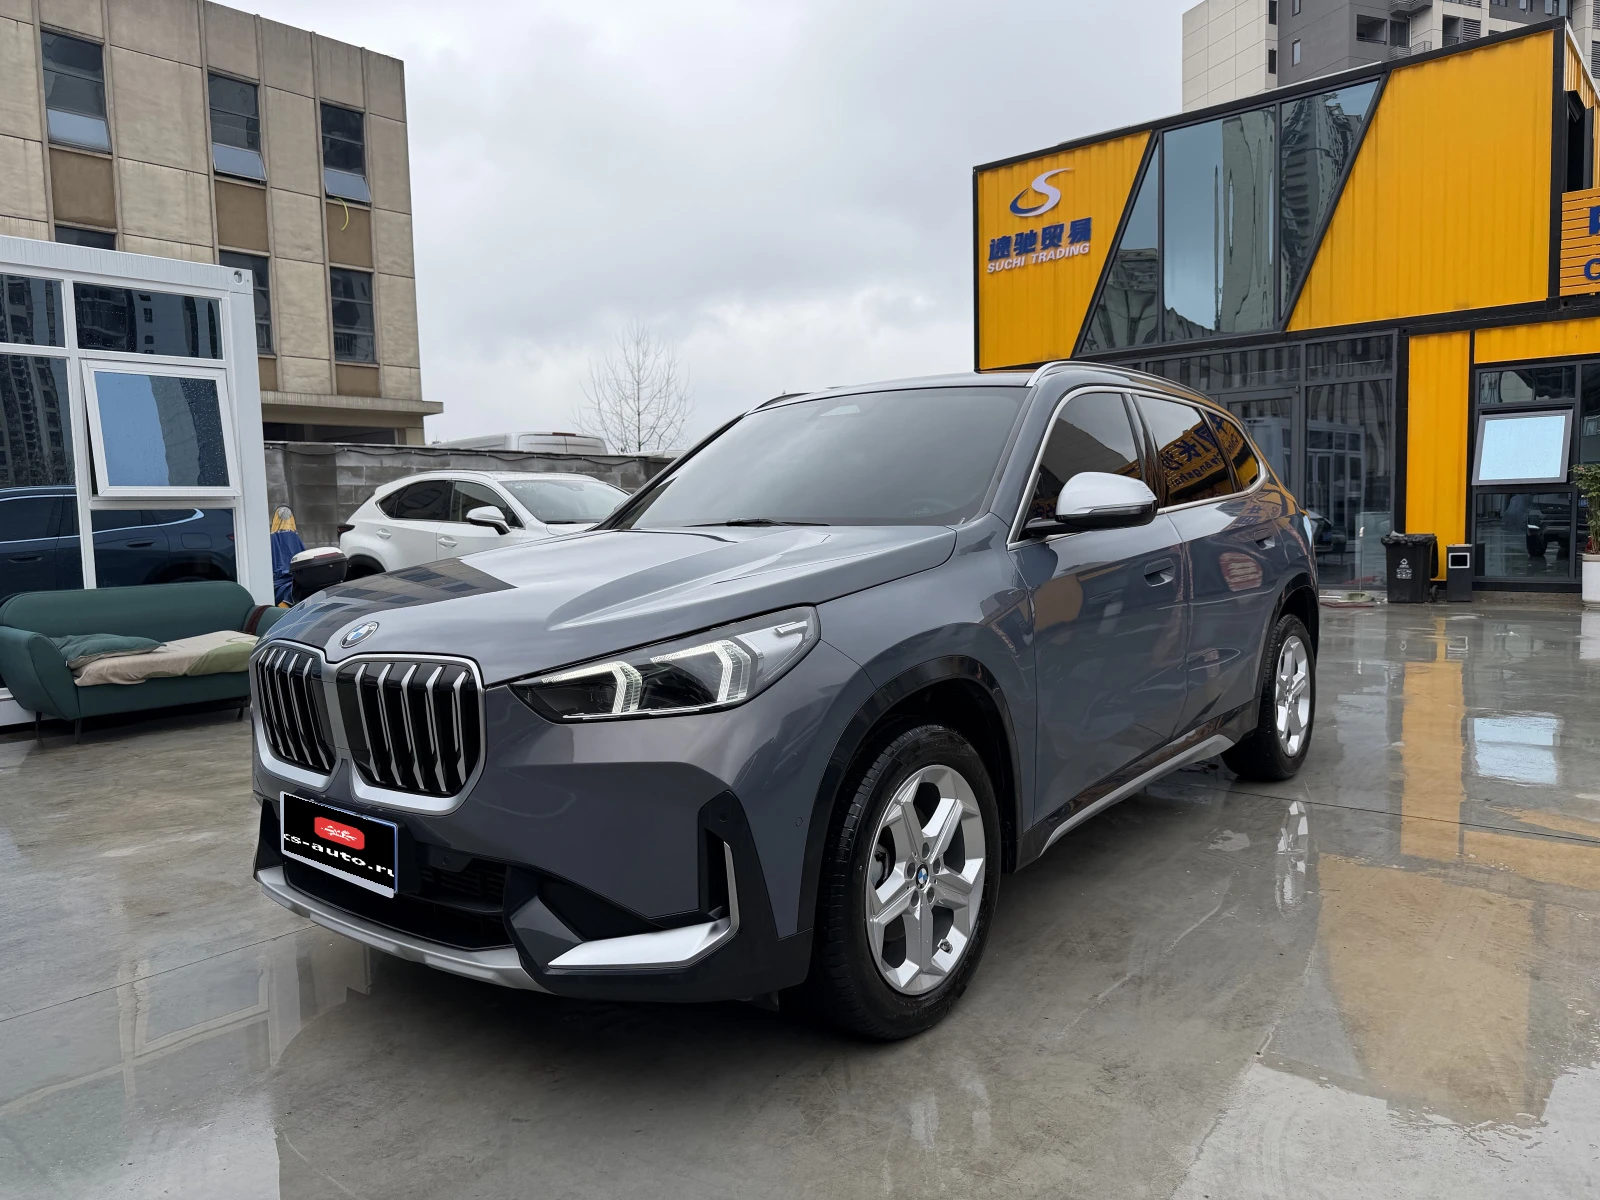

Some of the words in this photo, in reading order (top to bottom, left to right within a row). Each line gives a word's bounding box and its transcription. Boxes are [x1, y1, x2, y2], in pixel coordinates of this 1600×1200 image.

[988, 217, 1092, 261] 速驰贸易
[987, 256, 1026, 273] SUCHI
[1031, 243, 1091, 263] TRADING
